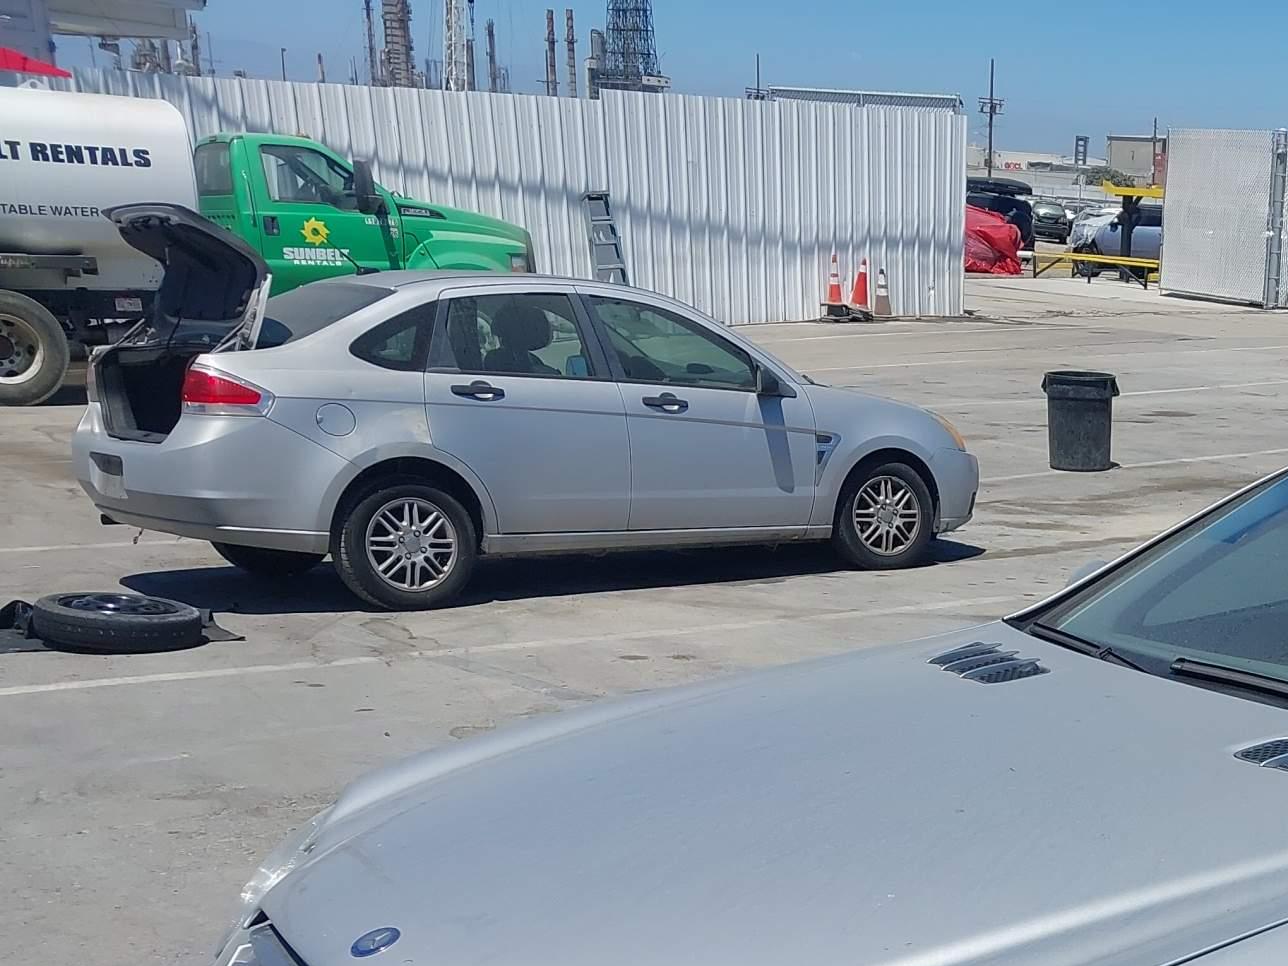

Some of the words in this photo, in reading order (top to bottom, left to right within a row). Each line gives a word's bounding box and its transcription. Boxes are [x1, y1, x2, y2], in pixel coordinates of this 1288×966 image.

[29, 142, 152, 168] RENTALS
[0, 204, 48, 216] TABLE
[50, 205, 100, 217] WATER
[283, 247, 350, 261] SUNBELT
